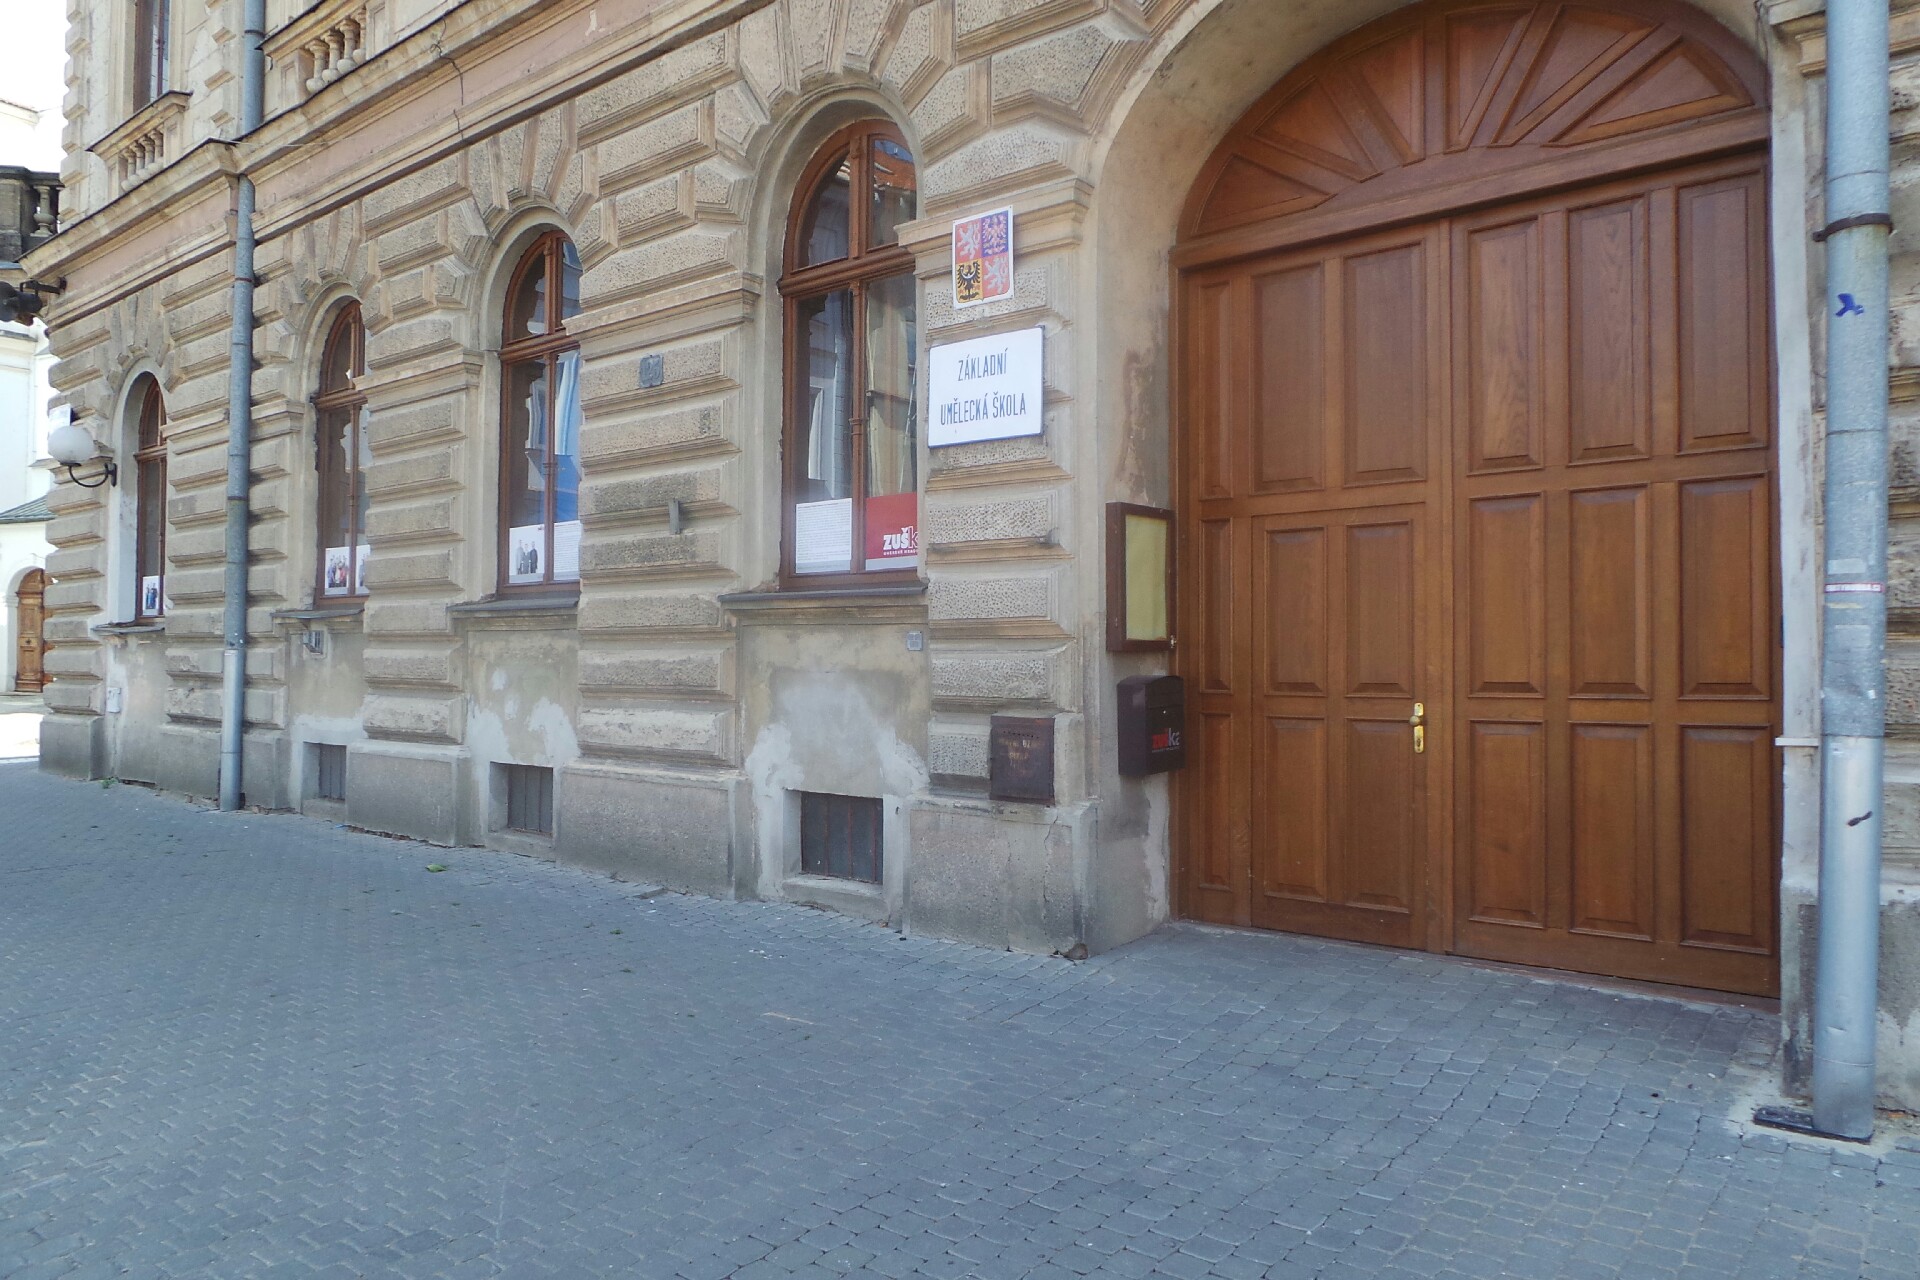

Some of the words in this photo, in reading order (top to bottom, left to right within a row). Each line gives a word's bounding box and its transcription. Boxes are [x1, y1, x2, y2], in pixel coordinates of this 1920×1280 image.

[957, 348, 1008, 382] ZÁKLADNÍ
[940, 394, 989, 426] UMĚLECKÁ
[992, 391, 1027, 419] ŠKOLA
